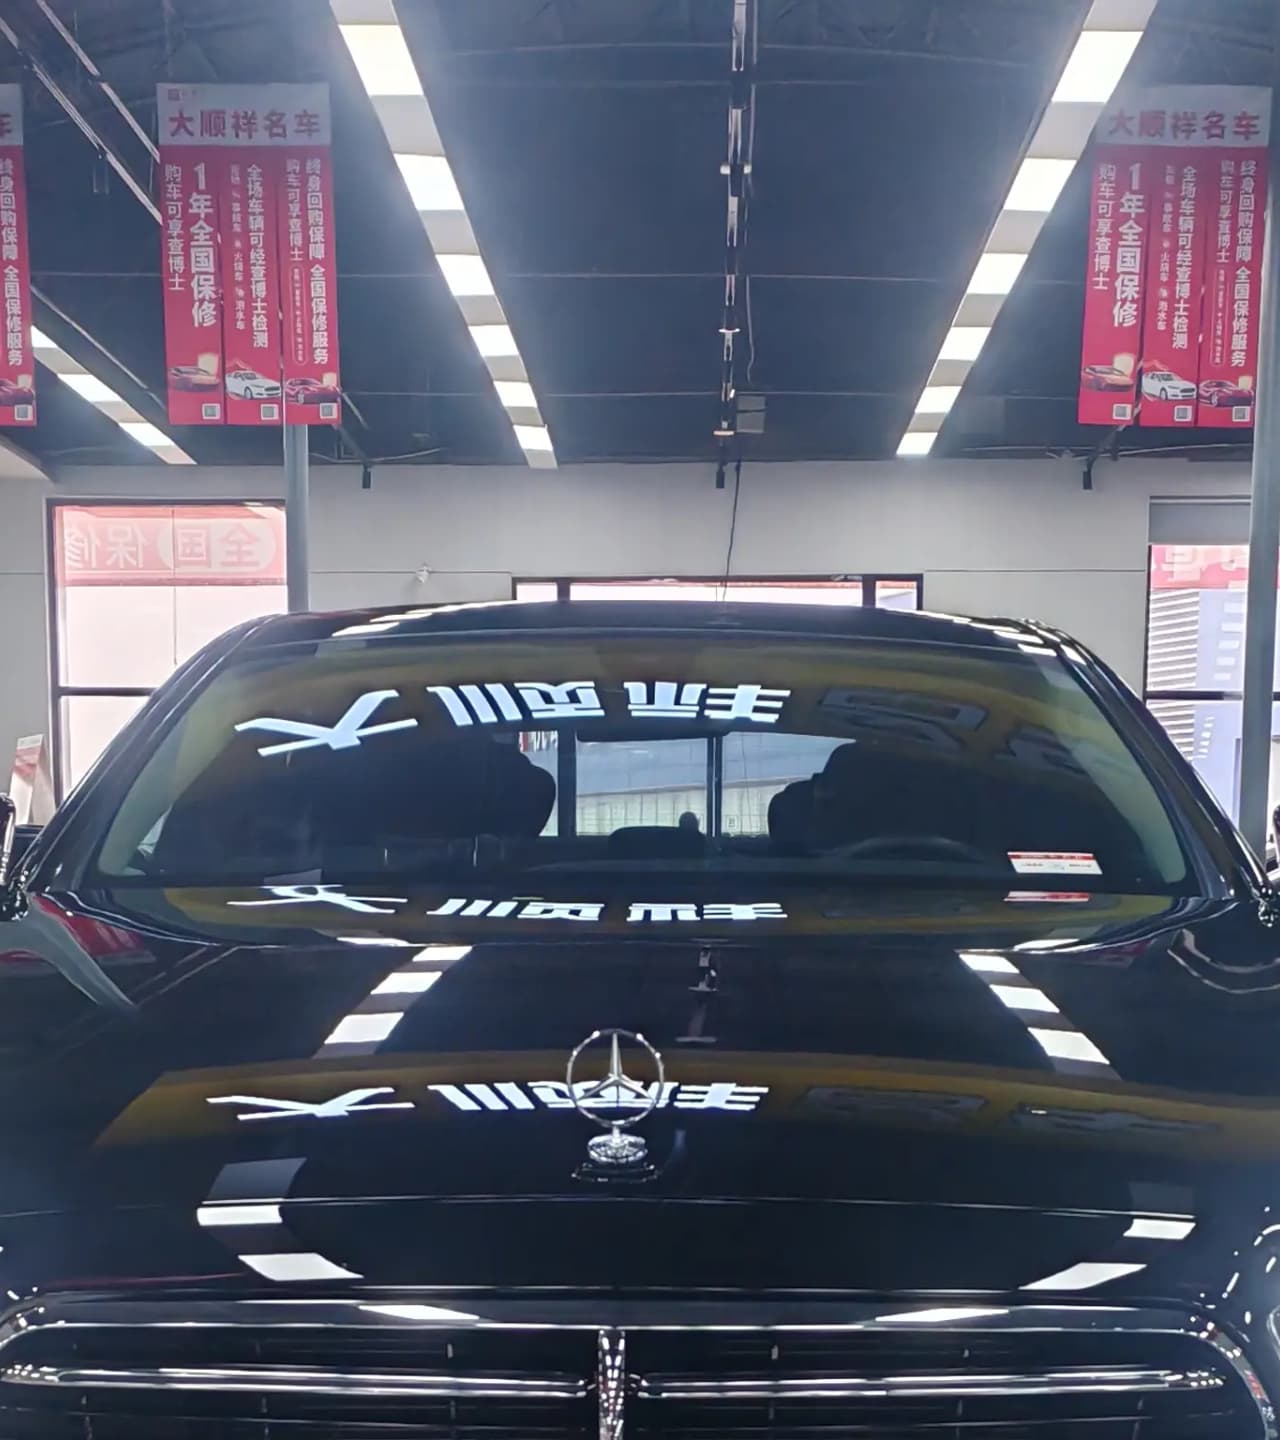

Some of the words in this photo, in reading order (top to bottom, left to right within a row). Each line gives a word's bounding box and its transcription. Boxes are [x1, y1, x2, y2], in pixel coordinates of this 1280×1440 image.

[168, 108, 320, 138] 大顺祥名车
[1108, 110, 1261, 140] 大顺祥名车
[188, 162, 217, 329] 1年全国保修
[1112, 162, 1145, 328] 1年全国保修
